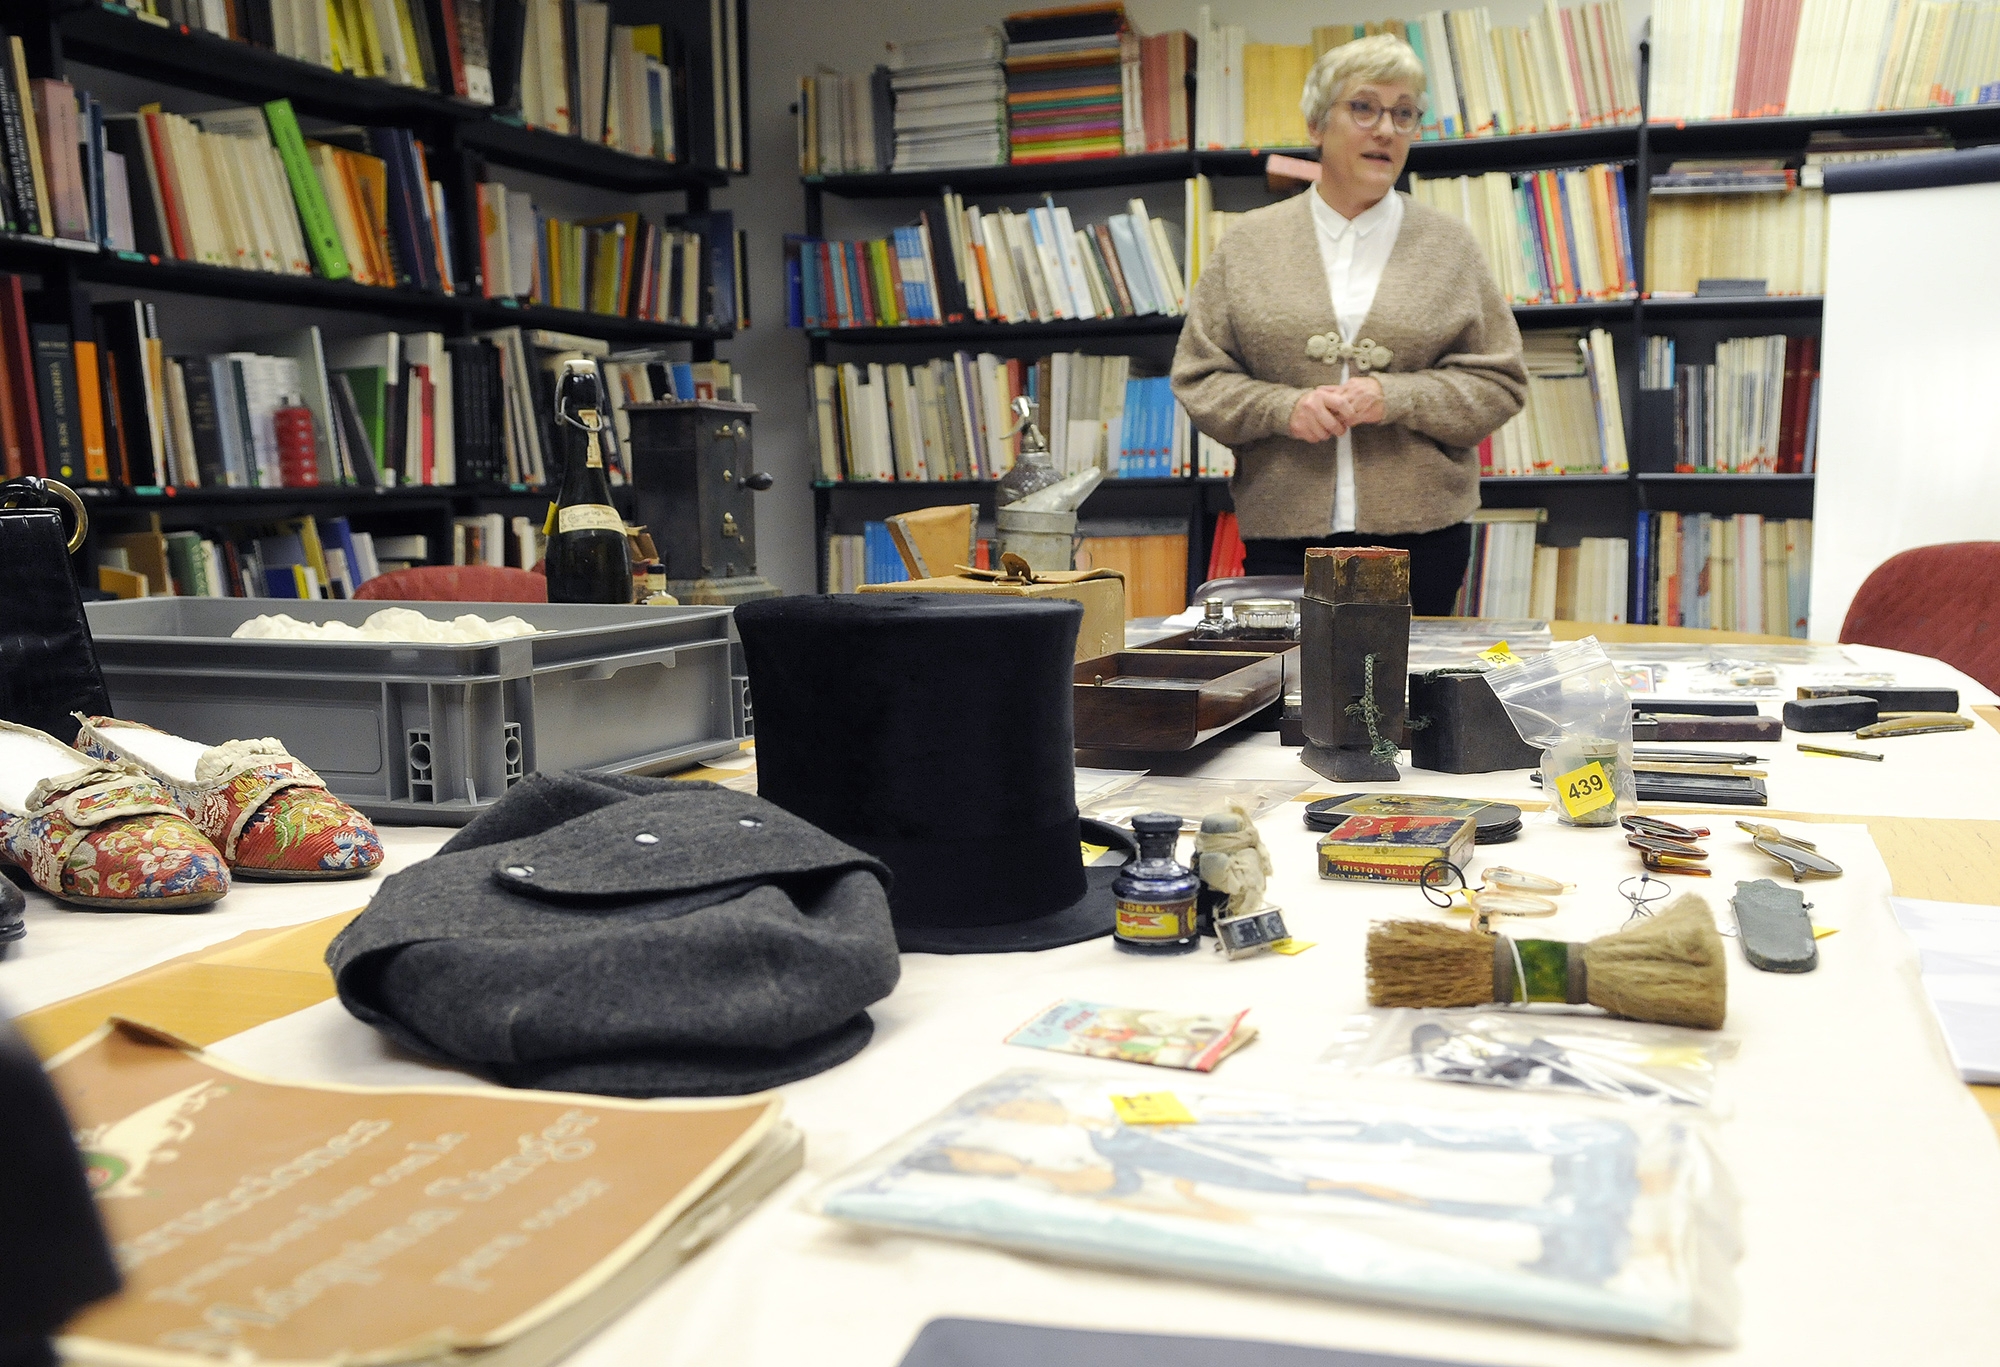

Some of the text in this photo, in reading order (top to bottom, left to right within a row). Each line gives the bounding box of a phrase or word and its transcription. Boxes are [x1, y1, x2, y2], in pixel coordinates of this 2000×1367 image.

[1568, 774, 1604, 799] 439
[1335, 863, 1381, 875] ARISTON
[1385, 867, 1398, 875] DE
[1123, 903, 1165, 914] IDEAL
[424, 1108, 600, 1204] Singer
